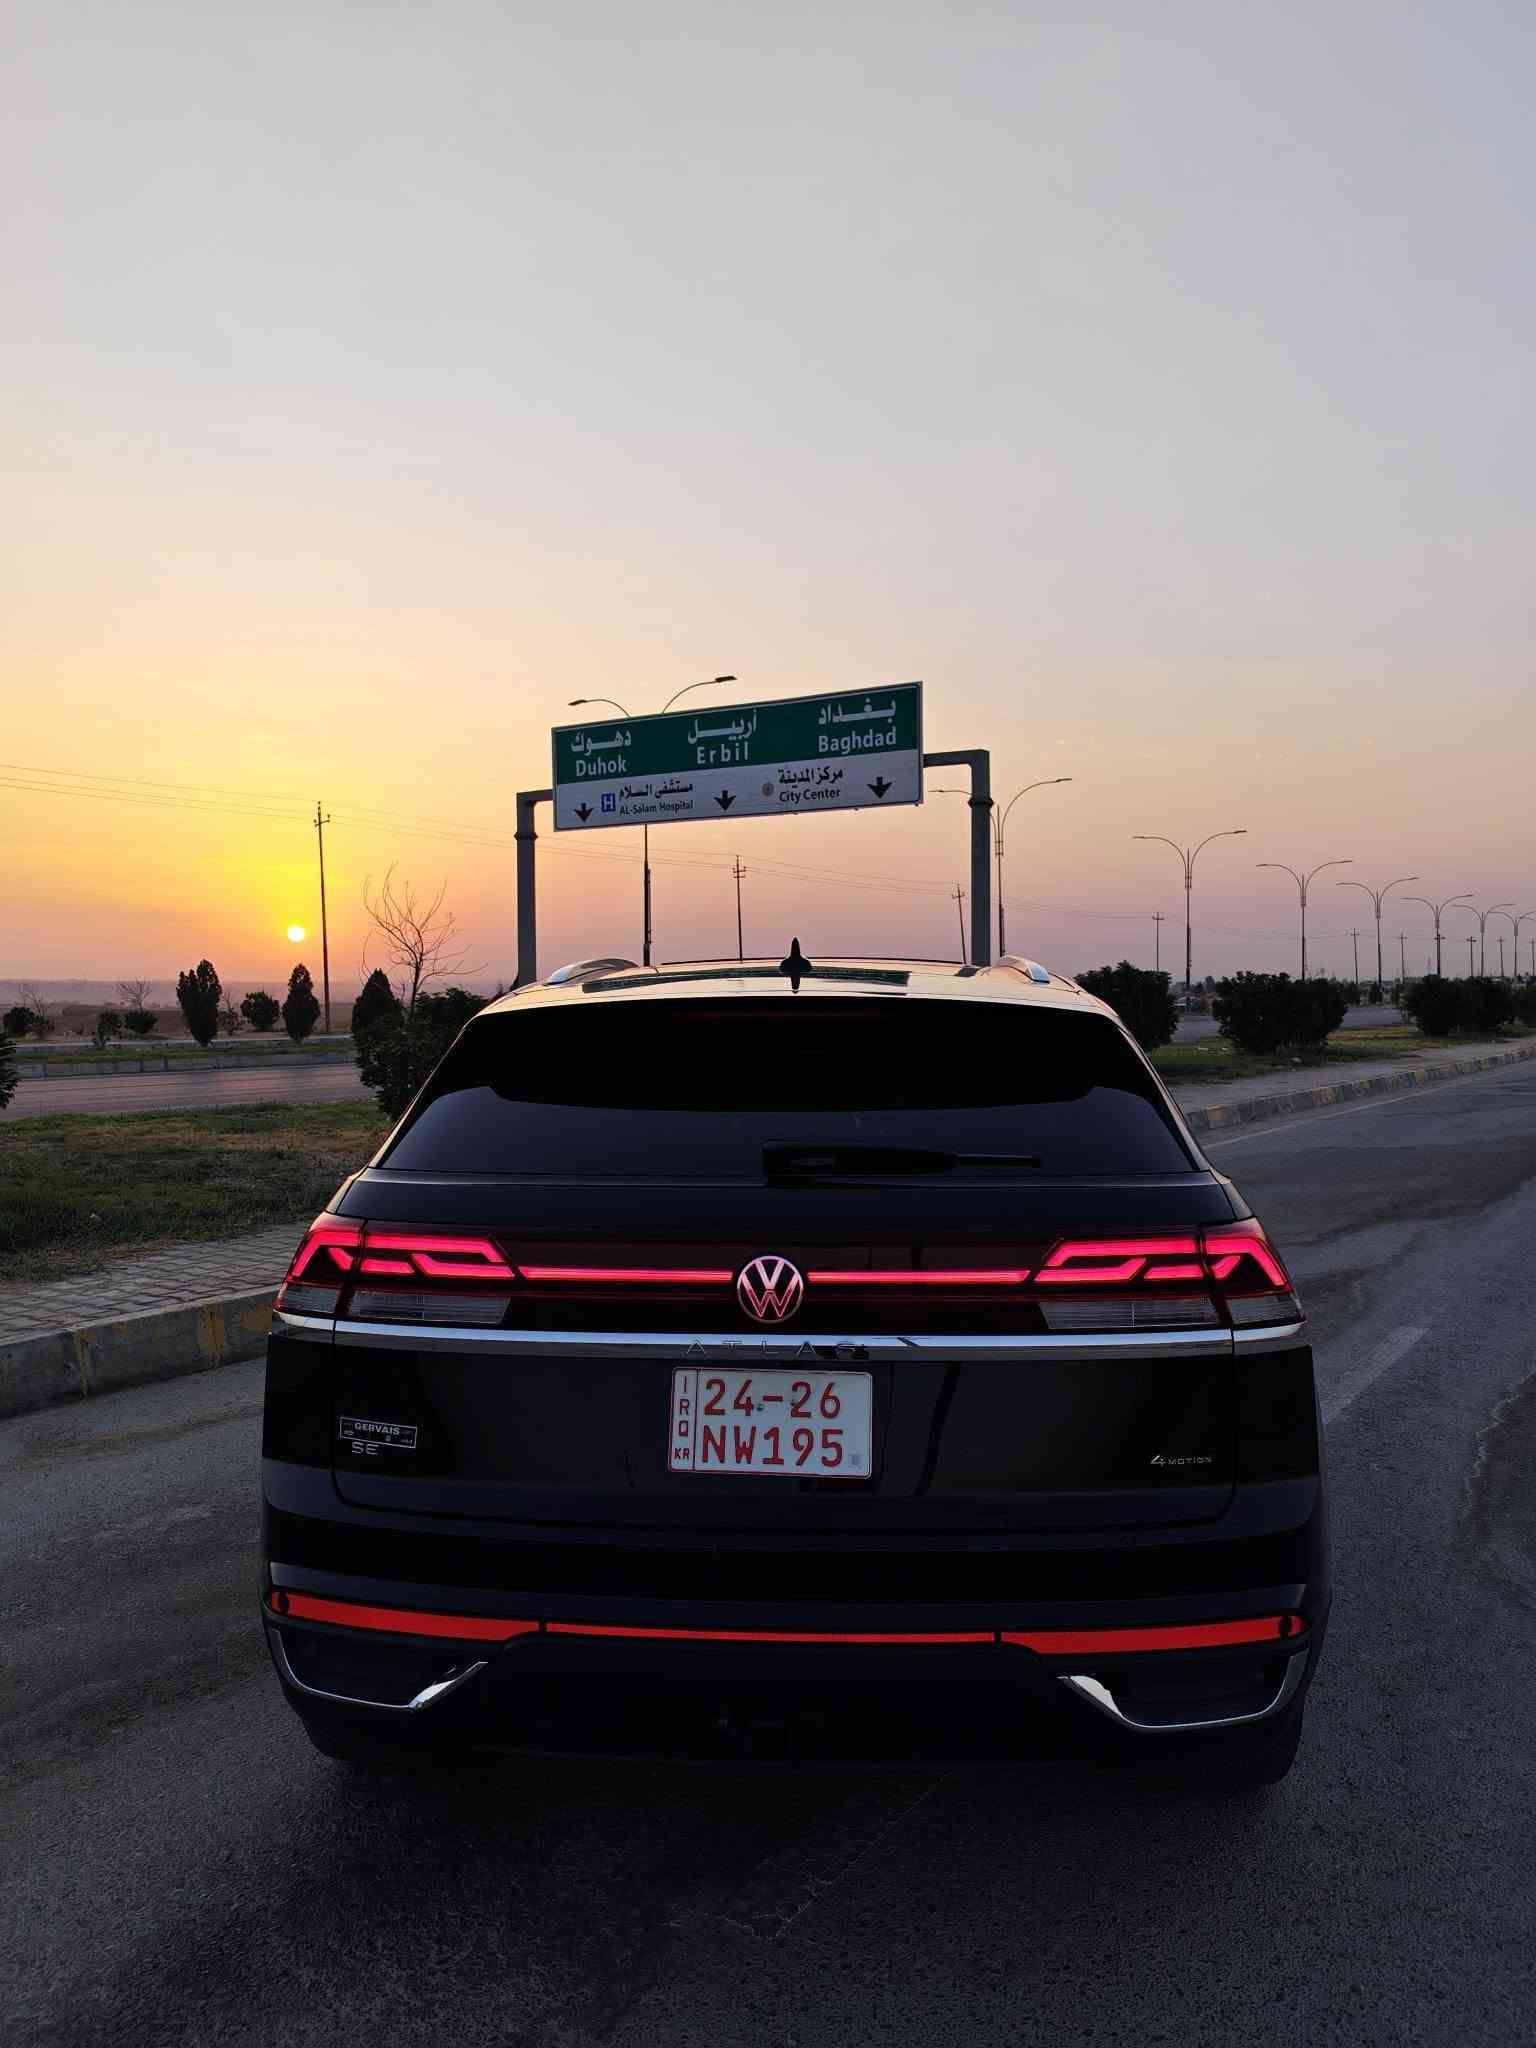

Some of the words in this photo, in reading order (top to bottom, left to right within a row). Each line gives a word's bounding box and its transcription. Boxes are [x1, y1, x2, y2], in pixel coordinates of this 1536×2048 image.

[818, 698, 897, 725] بغداد
[687, 709, 758, 744] أربيل
[570, 730, 632, 756] دهوك
[818, 726, 897, 755] Baghdad
[697, 740, 749, 764] Erbil
[575, 754, 627, 777] Duhok
[816, 766, 843, 785] مركز
[655, 777, 693, 798] مستشفى
[778, 767, 815, 788] المدينة
[619, 783, 653, 800] السلام
[779, 789, 801, 804] City
[803, 788, 841, 800] Center
[619, 802, 657, 816] AL-Salam
[659, 799, 694, 815] Hospital
[703, 1378, 842, 1419] 24-26
[354, 1422, 401, 1436] GERVAIS
[351, 1441, 379, 1455] SE
[674, 1447, 690, 1460] KR
[702, 1424, 844, 1467] NW195
